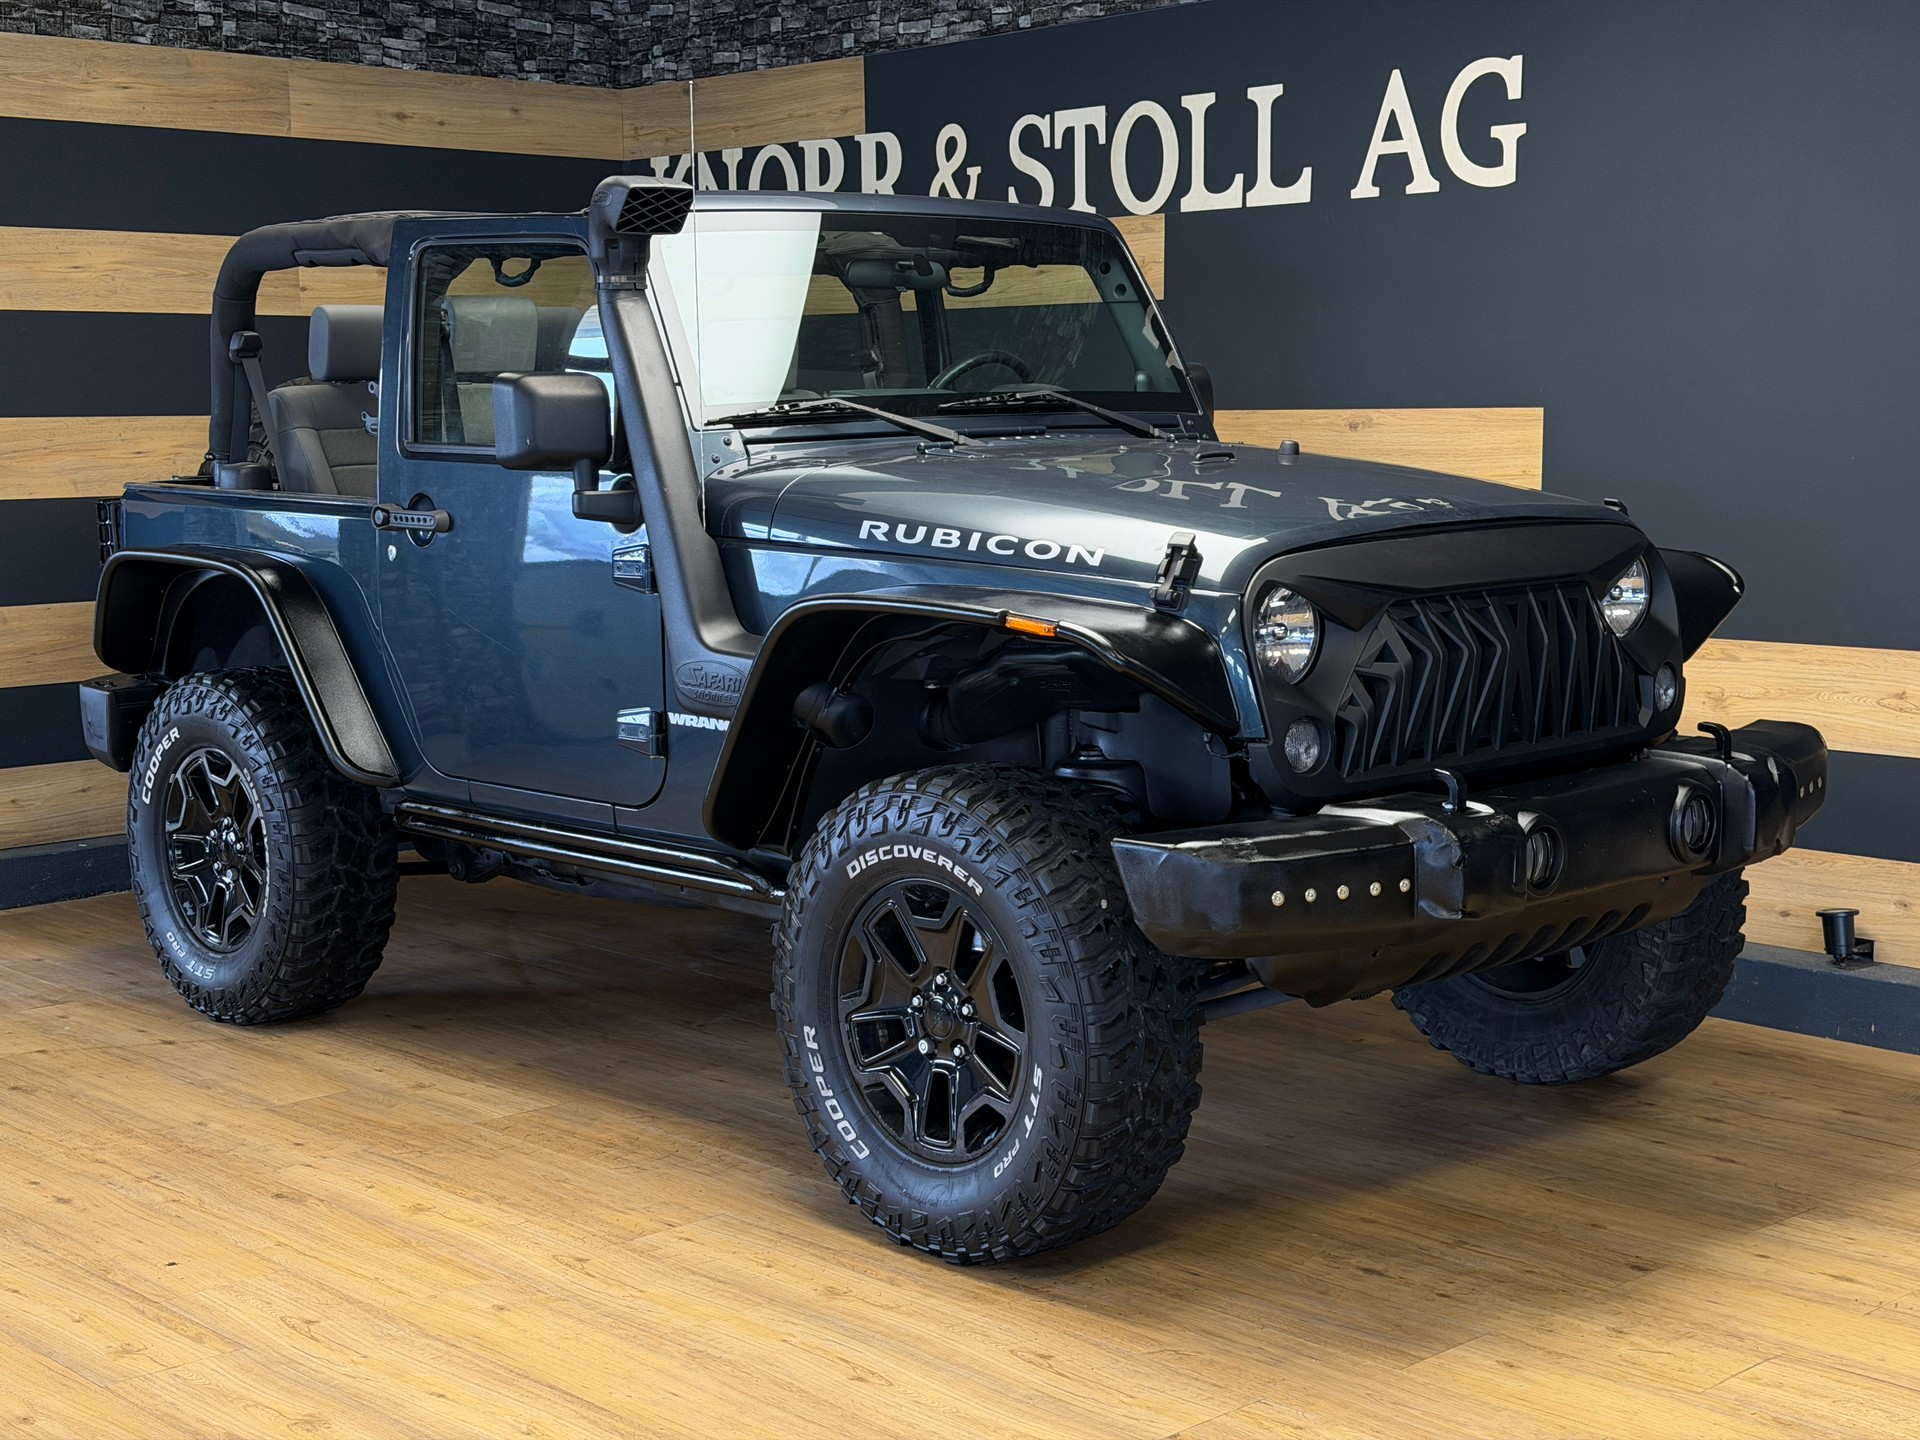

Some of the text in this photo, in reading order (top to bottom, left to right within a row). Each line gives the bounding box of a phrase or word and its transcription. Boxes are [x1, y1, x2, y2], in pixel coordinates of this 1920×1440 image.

[929, 123, 981, 200] &
[1008, 84, 1312, 215] STOLL
[1350, 54, 1527, 200] AG
[858, 520, 1106, 567] RUBICON
[683, 664, 742, 693] SAFARI
[667, 711, 731, 731] WRAN
[141, 726, 181, 805] COOPER
[845, 844, 984, 897] DISCOVERER
[166, 931, 216, 980] STT PRO
[803, 1025, 870, 1160] COOPER
[993, 1063, 1043, 1179] STT PRO
